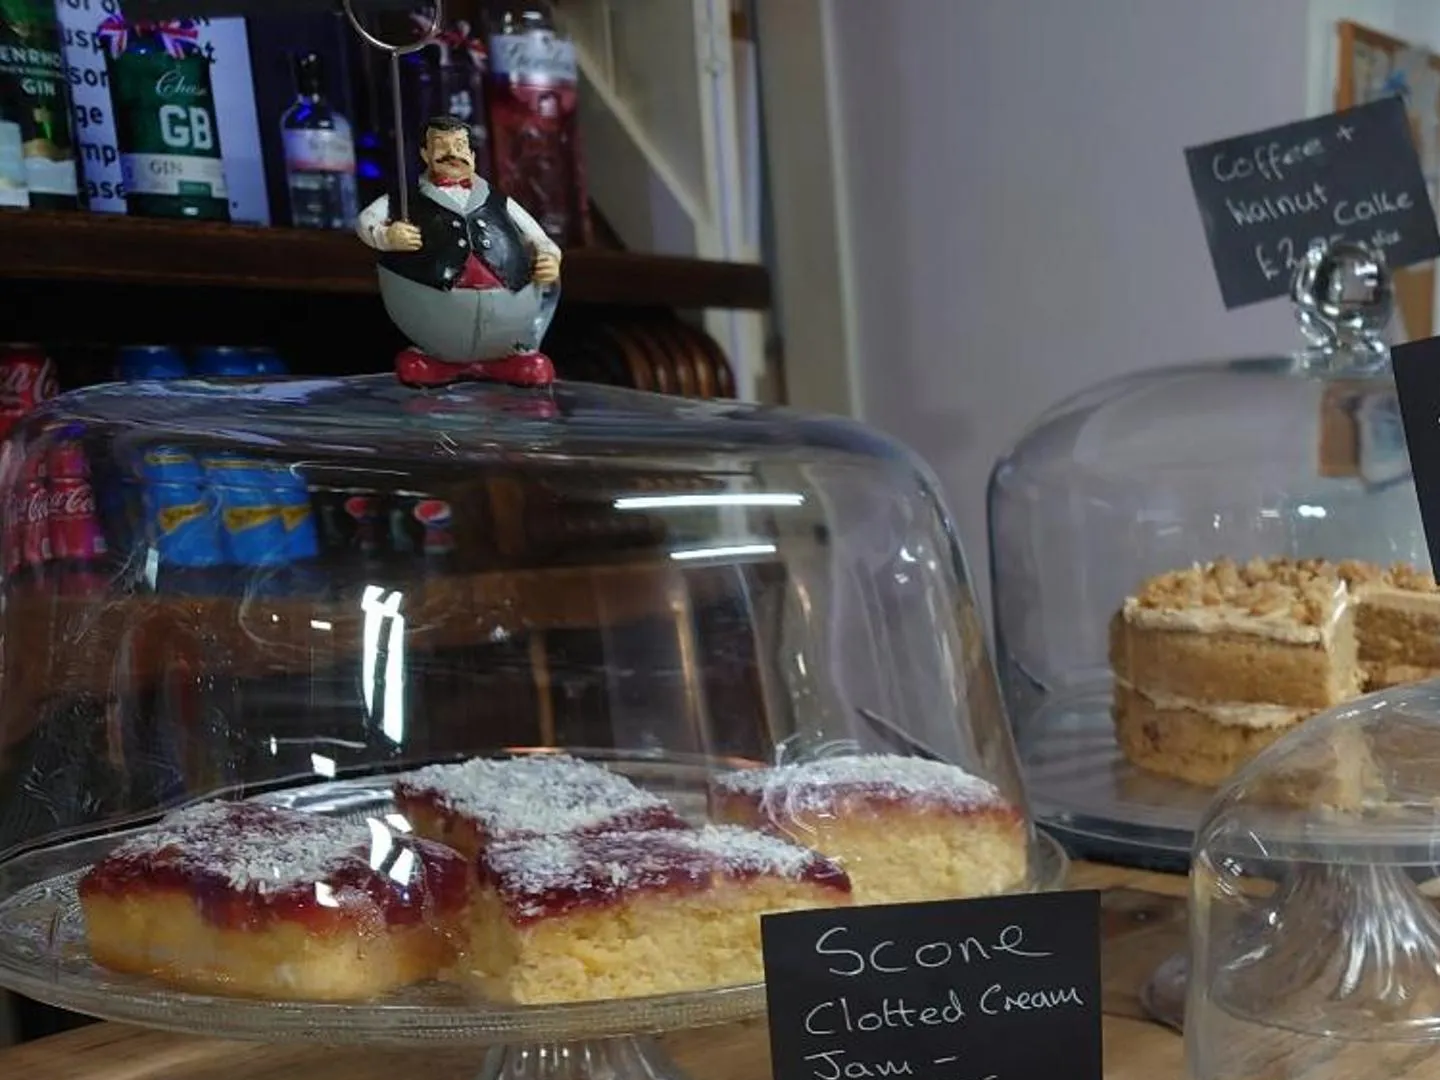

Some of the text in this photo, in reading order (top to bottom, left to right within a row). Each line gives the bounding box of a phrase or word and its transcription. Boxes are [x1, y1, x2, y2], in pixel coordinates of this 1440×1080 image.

[20, 77, 56, 96] GIN
[158, 103, 214, 150] GB
[150, 158, 183, 176] GIN
[1226, 182, 1414, 226] Walnut Cake
[815, 925, 1053, 976] Scone
[804, 984, 1084, 1035] Clotted Cream
[803, 1050, 914, 1080] Jam
